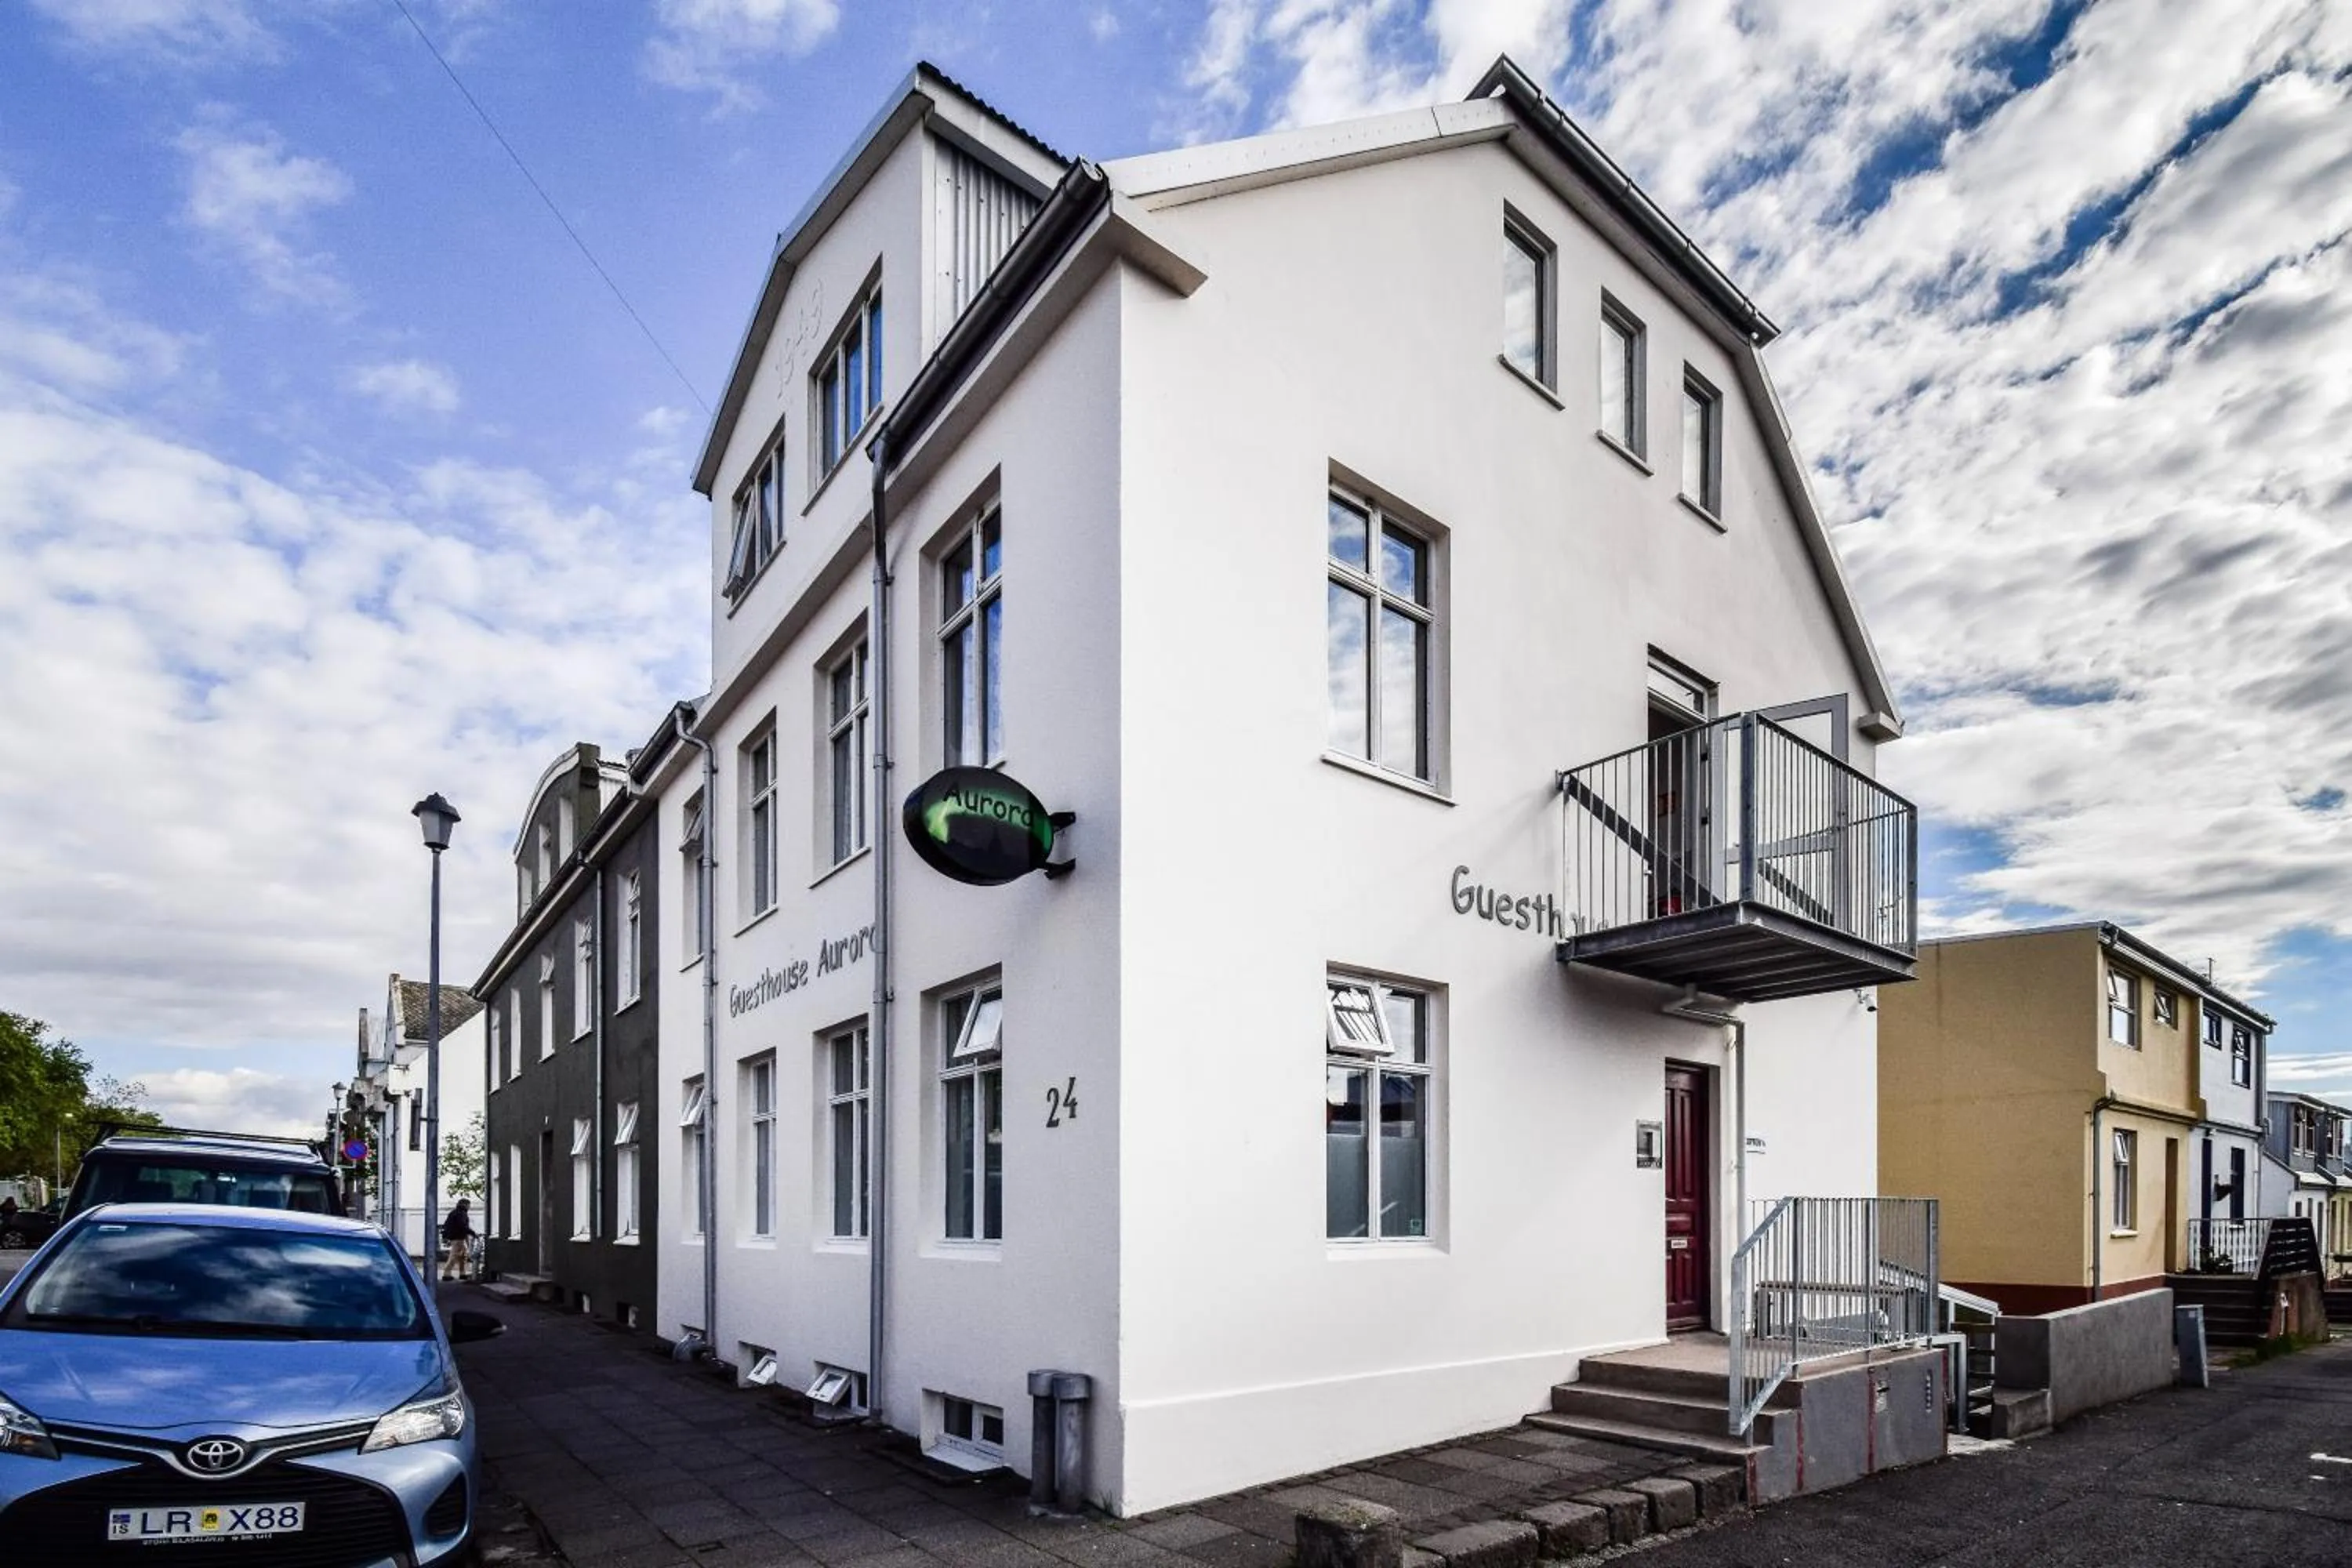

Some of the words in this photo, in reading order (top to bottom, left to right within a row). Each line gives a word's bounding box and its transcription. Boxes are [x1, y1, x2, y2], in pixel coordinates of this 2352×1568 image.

[943, 783, 1033, 826] Aurora
[1451, 865, 1610, 939] Guesth
[730, 960, 808, 1018] Guesthouse
[1046, 1076, 1078, 1127] 24
[112, 1525, 129, 1534] IS
[140, 1512, 192, 1534] LR
[227, 1506, 299, 1531] X88
